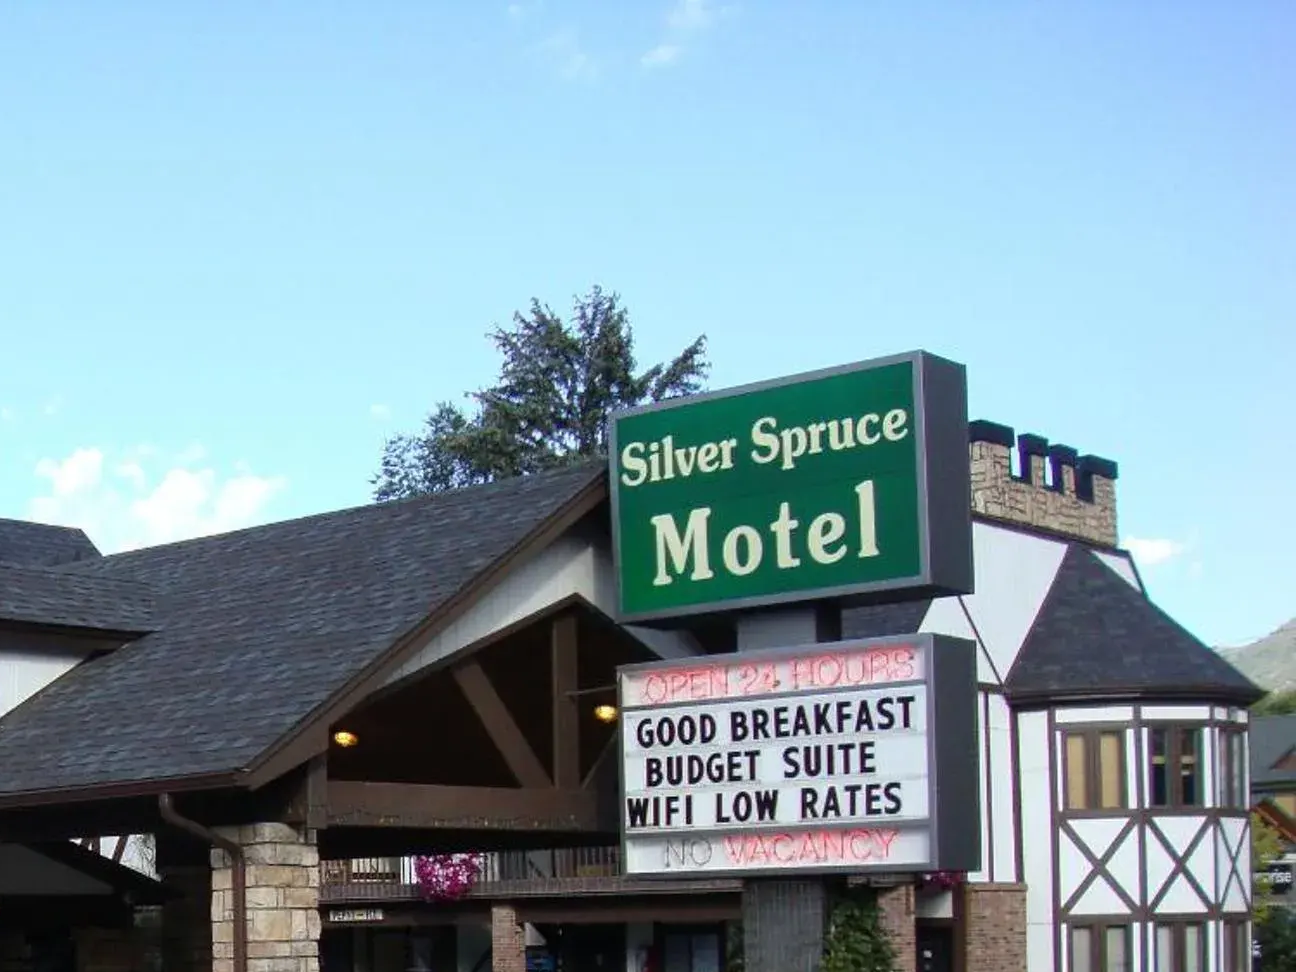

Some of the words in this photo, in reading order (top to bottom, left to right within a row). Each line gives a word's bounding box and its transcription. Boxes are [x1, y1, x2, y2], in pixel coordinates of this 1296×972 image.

[621, 435, 737, 487] Silver
[751, 408, 909, 470] Spruce
[650, 480, 880, 586] Motel
[645, 664, 729, 705] OPEN
[740, 661, 781, 696] 24
[791, 645, 915, 689] HOURS
[637, 713, 717, 749] GOOD
[730, 696, 916, 742] BREAKFAST
[646, 749, 761, 787] BUDGET
[783, 741, 876, 778] SUITE
[627, 796, 693, 828] WIFI
[716, 789, 779, 823] LOW
[803, 782, 902, 818] RATES
[664, 836, 713, 868] NO
[723, 829, 899, 866] VACANCY
